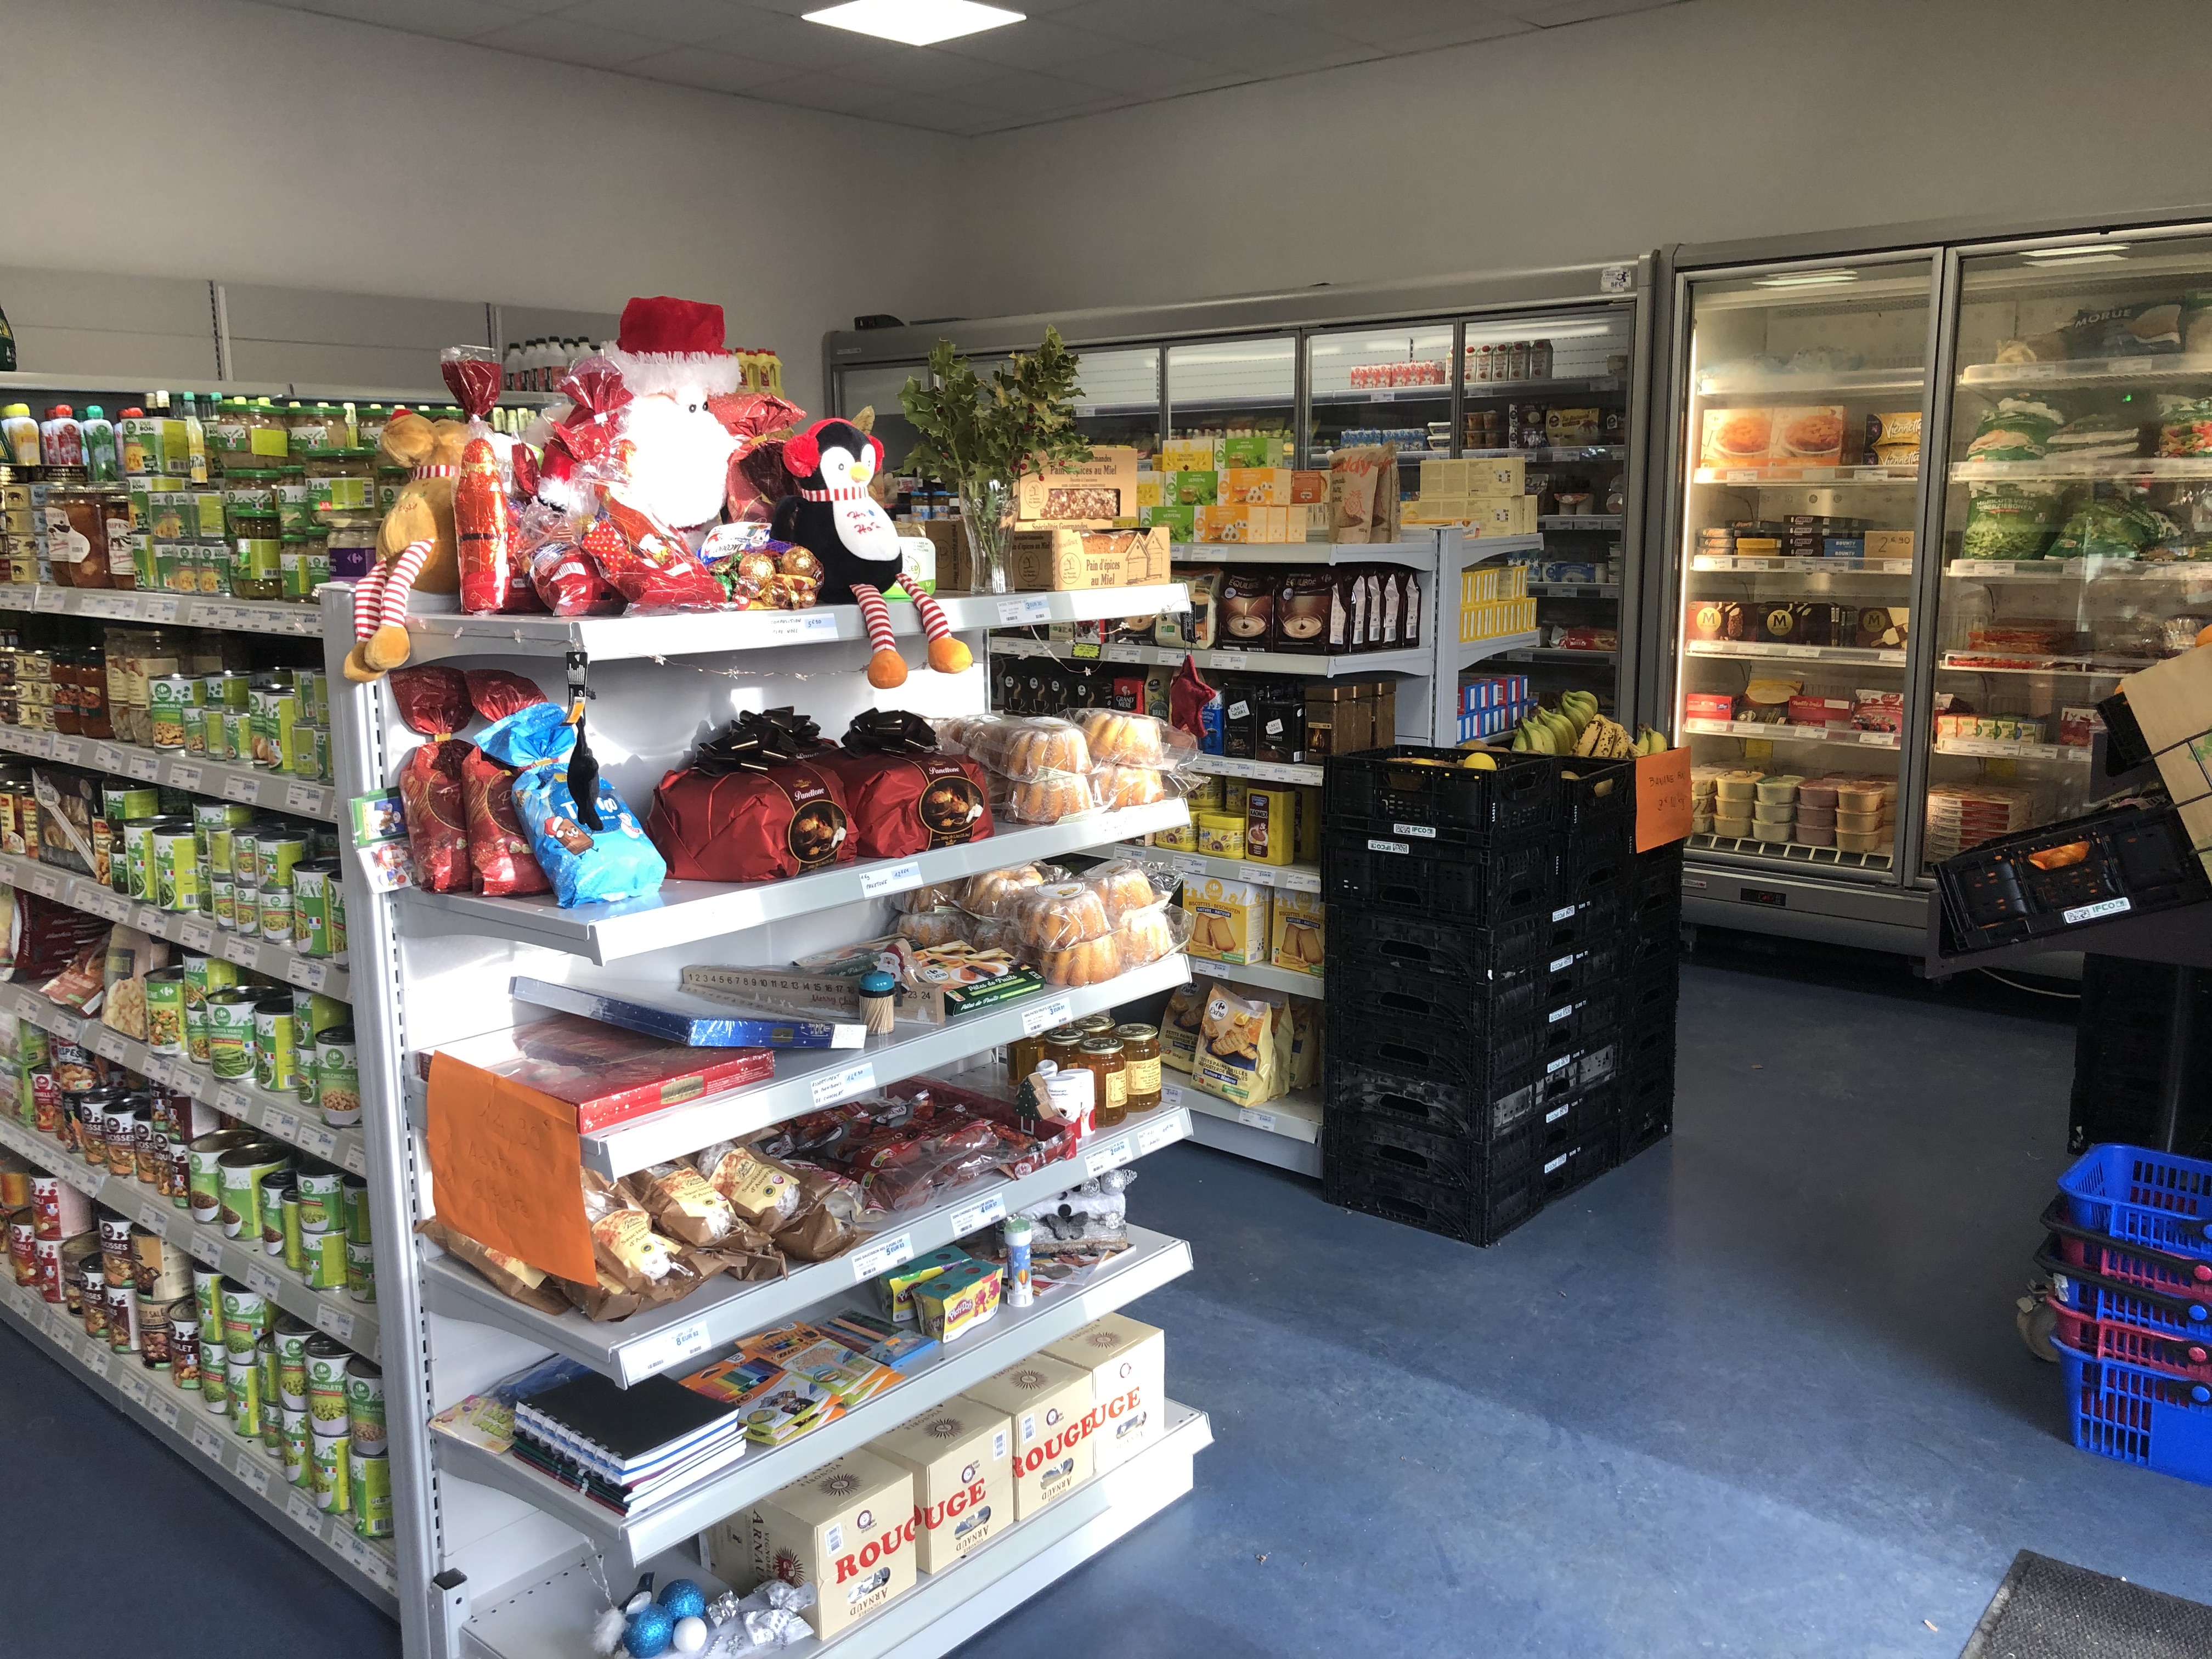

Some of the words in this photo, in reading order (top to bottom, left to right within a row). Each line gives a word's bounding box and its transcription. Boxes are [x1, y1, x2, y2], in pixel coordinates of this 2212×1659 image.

[2075, 308, 2131, 328] MORUE
[1104, 465, 1117, 475] Miel
[1086, 559, 1098, 571] Pain
[1099, 558, 1120, 572] d'épices
[1091, 577, 1099, 585] au
[1101, 573, 1115, 585] Miel
[1026, 601, 1031, 610] 3
[1702, 612, 1716, 625] M
[1772, 614, 1786, 627] M
[1231, 703, 1245, 713] CARTE
[1232, 709, 1246, 717] NOIRE
[1268, 721, 1280, 730] CARTE
[929, 766, 960, 775] Panettone
[1649, 775, 1674, 787] BANANE
[794, 787, 825, 802] Panettone
[1214, 904, 1240, 915] BESCHUITEN
[2092, 902, 2115, 913] IFCO
[968, 983, 987, 991] Pâtes
[995, 974, 1018, 984] Fruits
[760, 979, 768, 987] 10
[813, 983, 821, 991] 15
[908, 990, 918, 998] 23
[921, 991, 931, 1000] 24
[961, 1002, 975, 1011] Pâtes
[983, 995, 1000, 1005] Fruits
[1209, 1007, 1224, 1018] Extra
[1213, 1059, 1228, 1069] PAINS
[886, 1248, 890, 1256] 5
[891, 1245, 900, 1253] EUR
[676, 1338, 681, 1346] 8
[682, 1333, 692, 1342] EUR
[1042, 1476, 1073, 1500] ARNAUD
[956, 1525, 989, 1552] ARNAUD
[850, 1587, 888, 1616] ARNAUD
